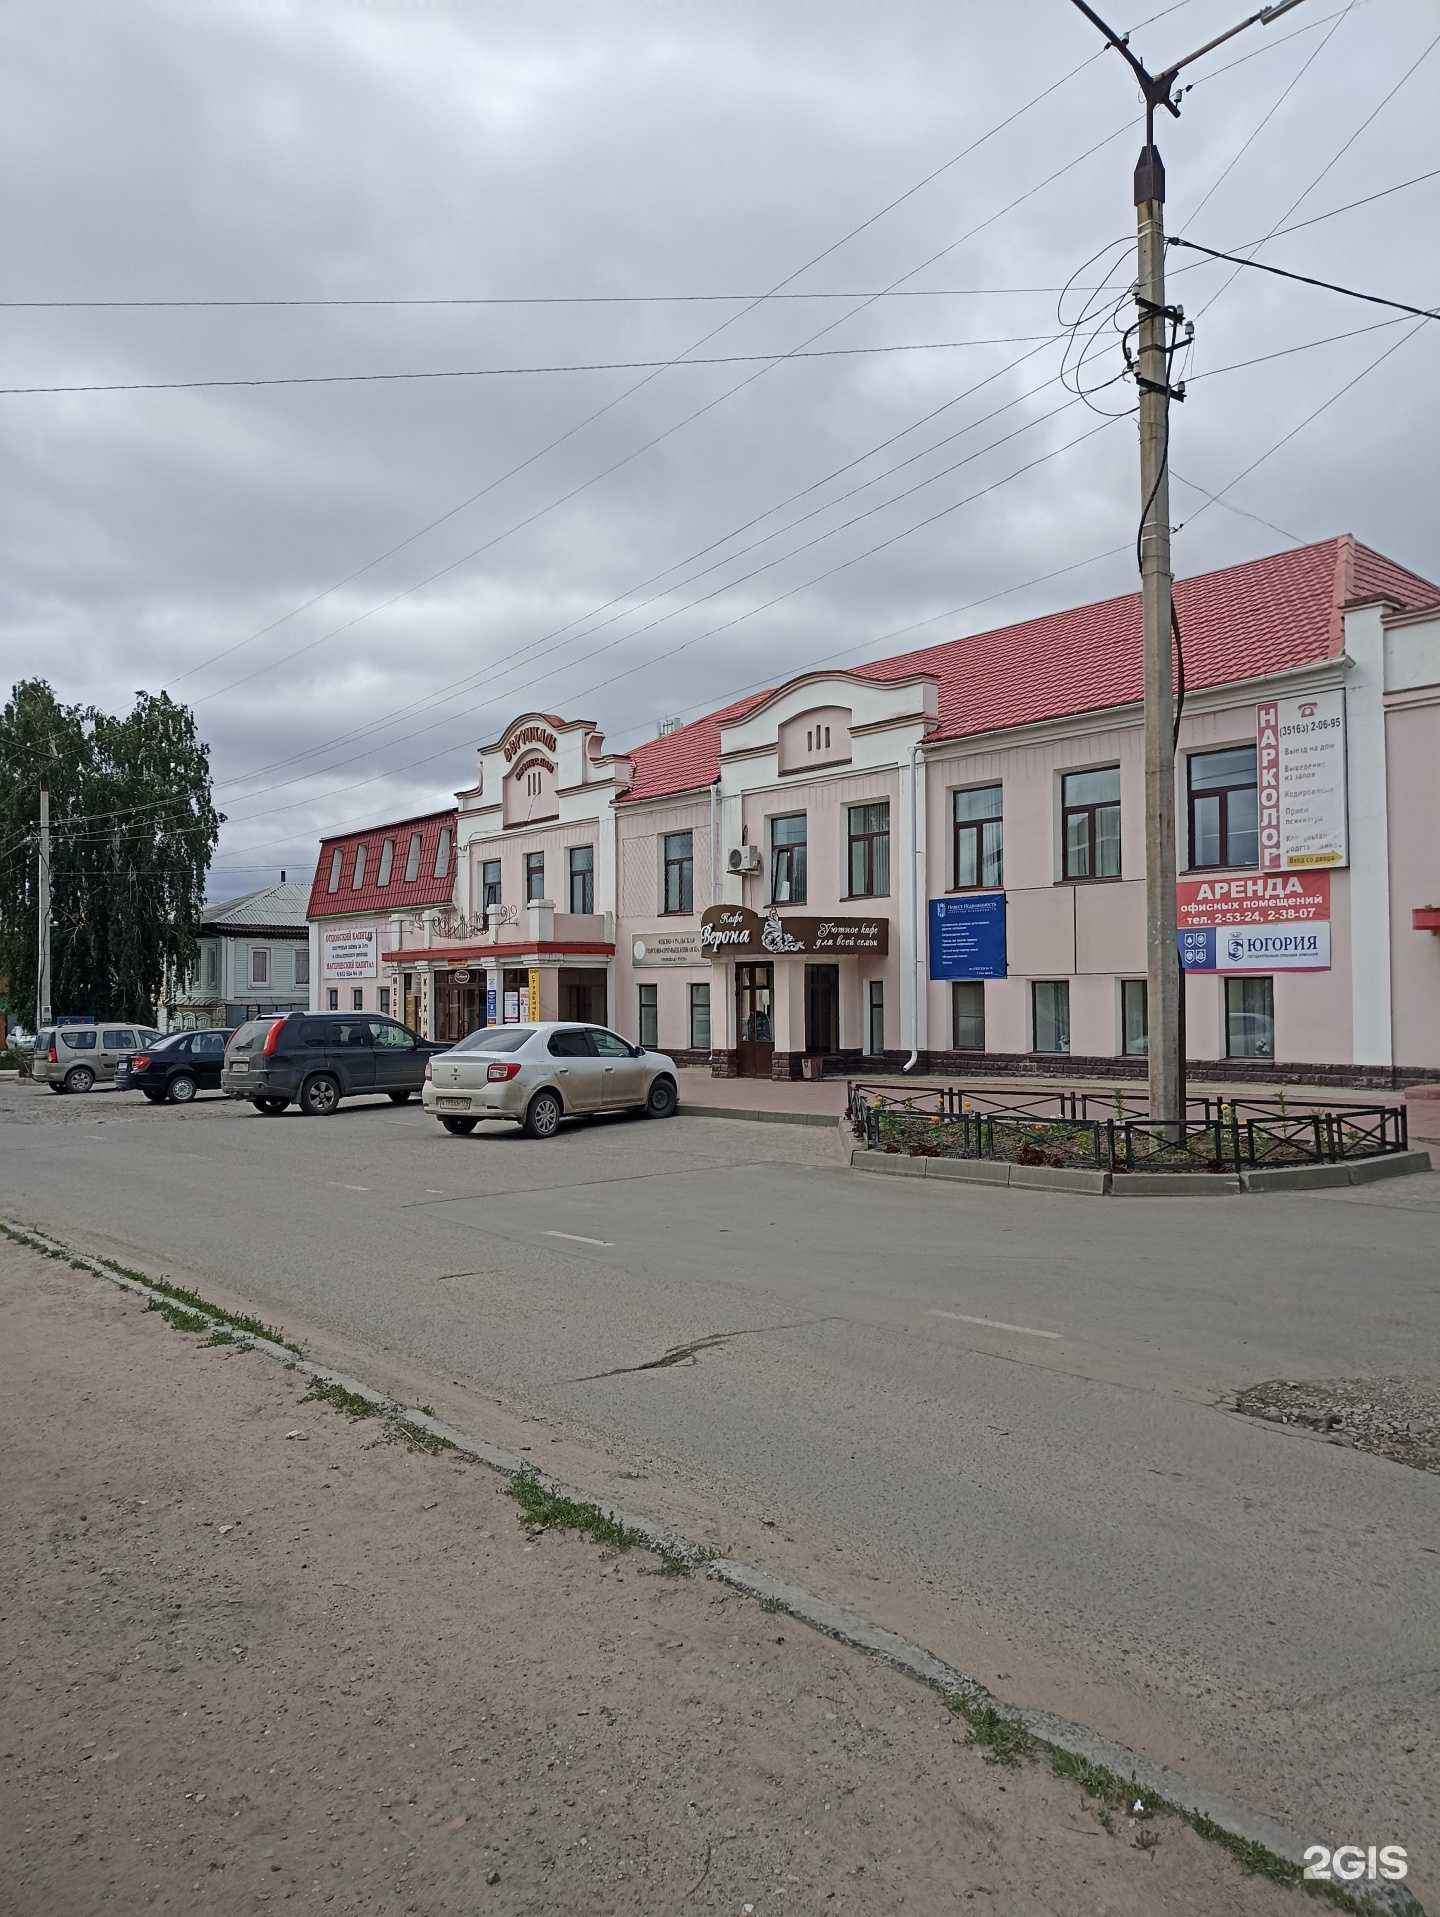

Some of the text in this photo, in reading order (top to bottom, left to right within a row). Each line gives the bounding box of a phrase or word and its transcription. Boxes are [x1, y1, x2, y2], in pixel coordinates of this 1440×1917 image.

[1280, 723, 1310, 738] (35163)
[1259, 709, 1281, 866] НАРКОЛОГ
[1197, 877, 1303, 900] АРЕНДА
[1180, 894, 1323, 914] офисных помещений
[719, 911, 744, 926] Кафе
[1187, 908, 1316, 925] тел. 2-53-24, 2-38-07
[701, 923, 750, 952] Верона
[818, 922, 879, 937] Уютное кафе
[813, 938, 834, 949] для
[836, 935, 854, 946] всей
[1247, 935, 1318, 951] ЮГОРИЯ
